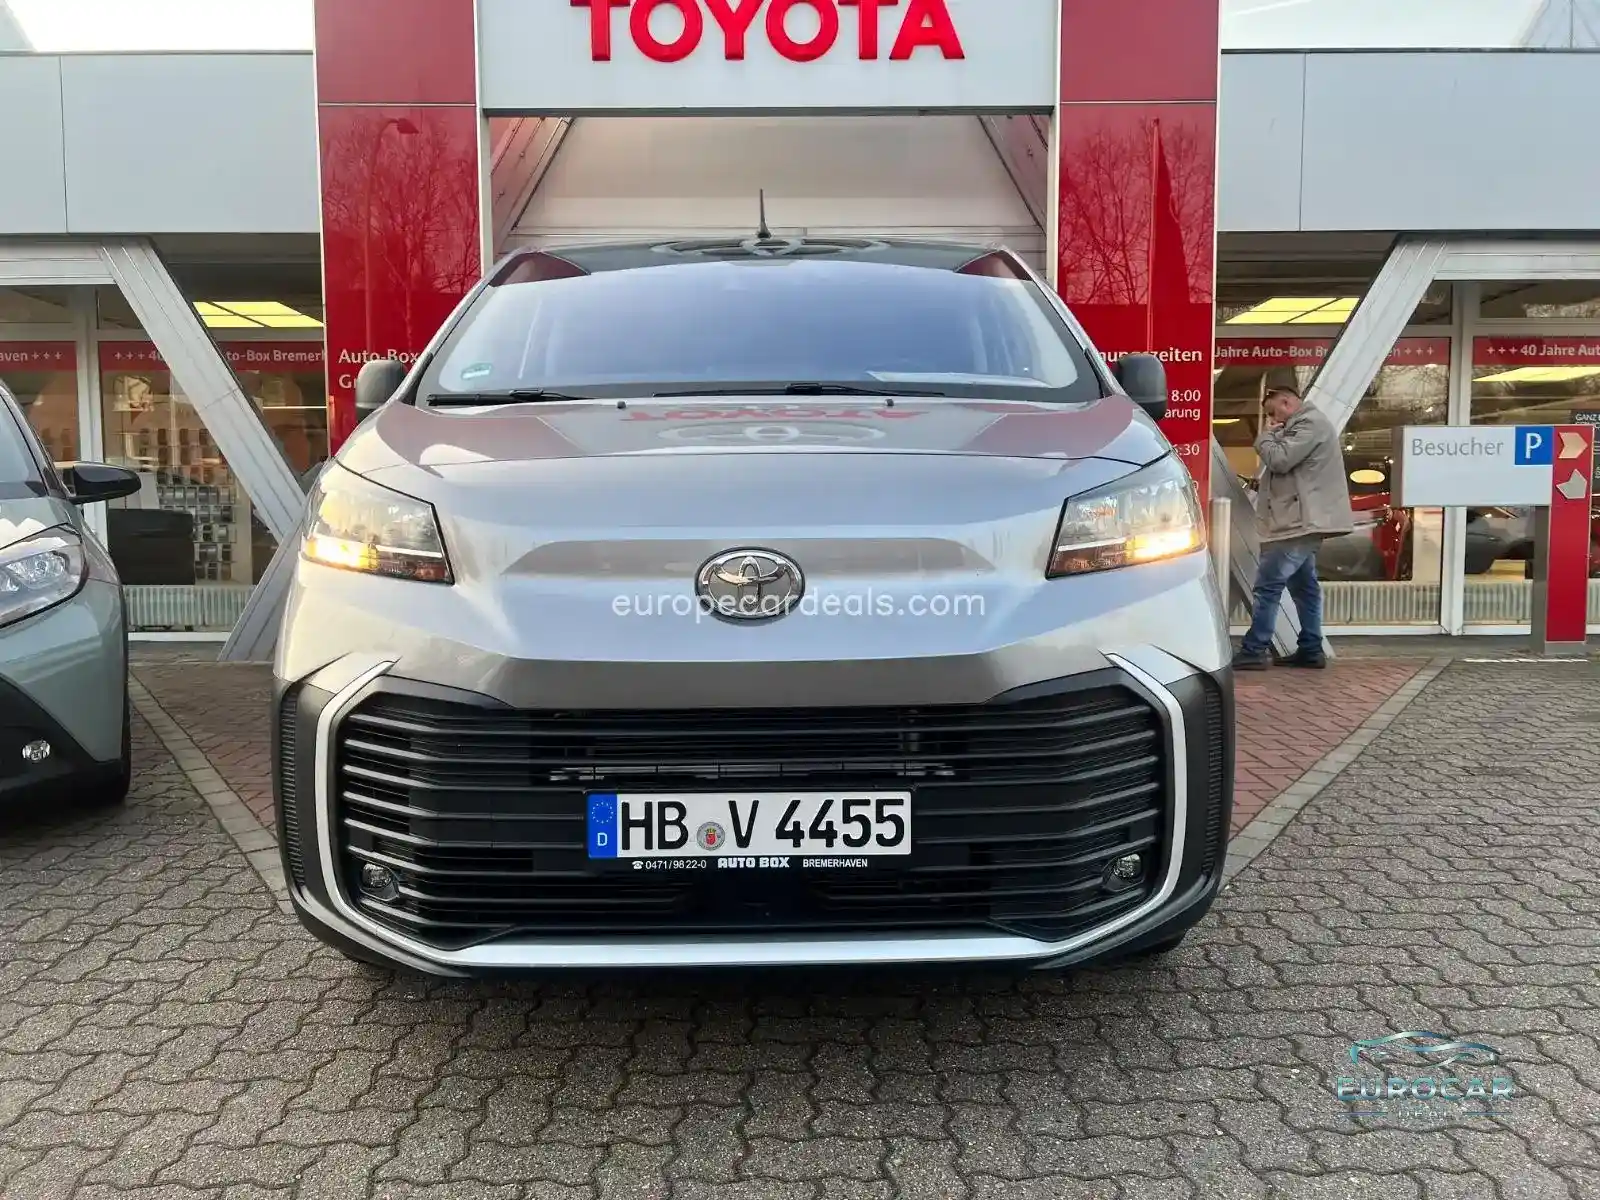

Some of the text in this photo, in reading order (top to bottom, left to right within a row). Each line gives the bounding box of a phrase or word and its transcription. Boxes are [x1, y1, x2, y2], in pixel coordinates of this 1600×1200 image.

[570, 0, 965, 62] TOYOTA
[338, 348, 419, 363] Auto-Box
[1251, 345, 1312, 357] Auto-Box
[1520, 344, 1537, 356] 40
[1538, 344, 1575, 356] Jahre
[1171, 389, 1201, 402] 8:00
[1164, 408, 1201, 420] arung
[1411, 438, 1504, 457] Besucher
[1526, 432, 1543, 459] P
[621, 798, 905, 851] HB V 4455
[597, 832, 608, 847] D
[717, 857, 756, 869] AUTO
[759, 857, 790, 868] BOX
[802, 858, 868, 868] BREMERHAVEN
